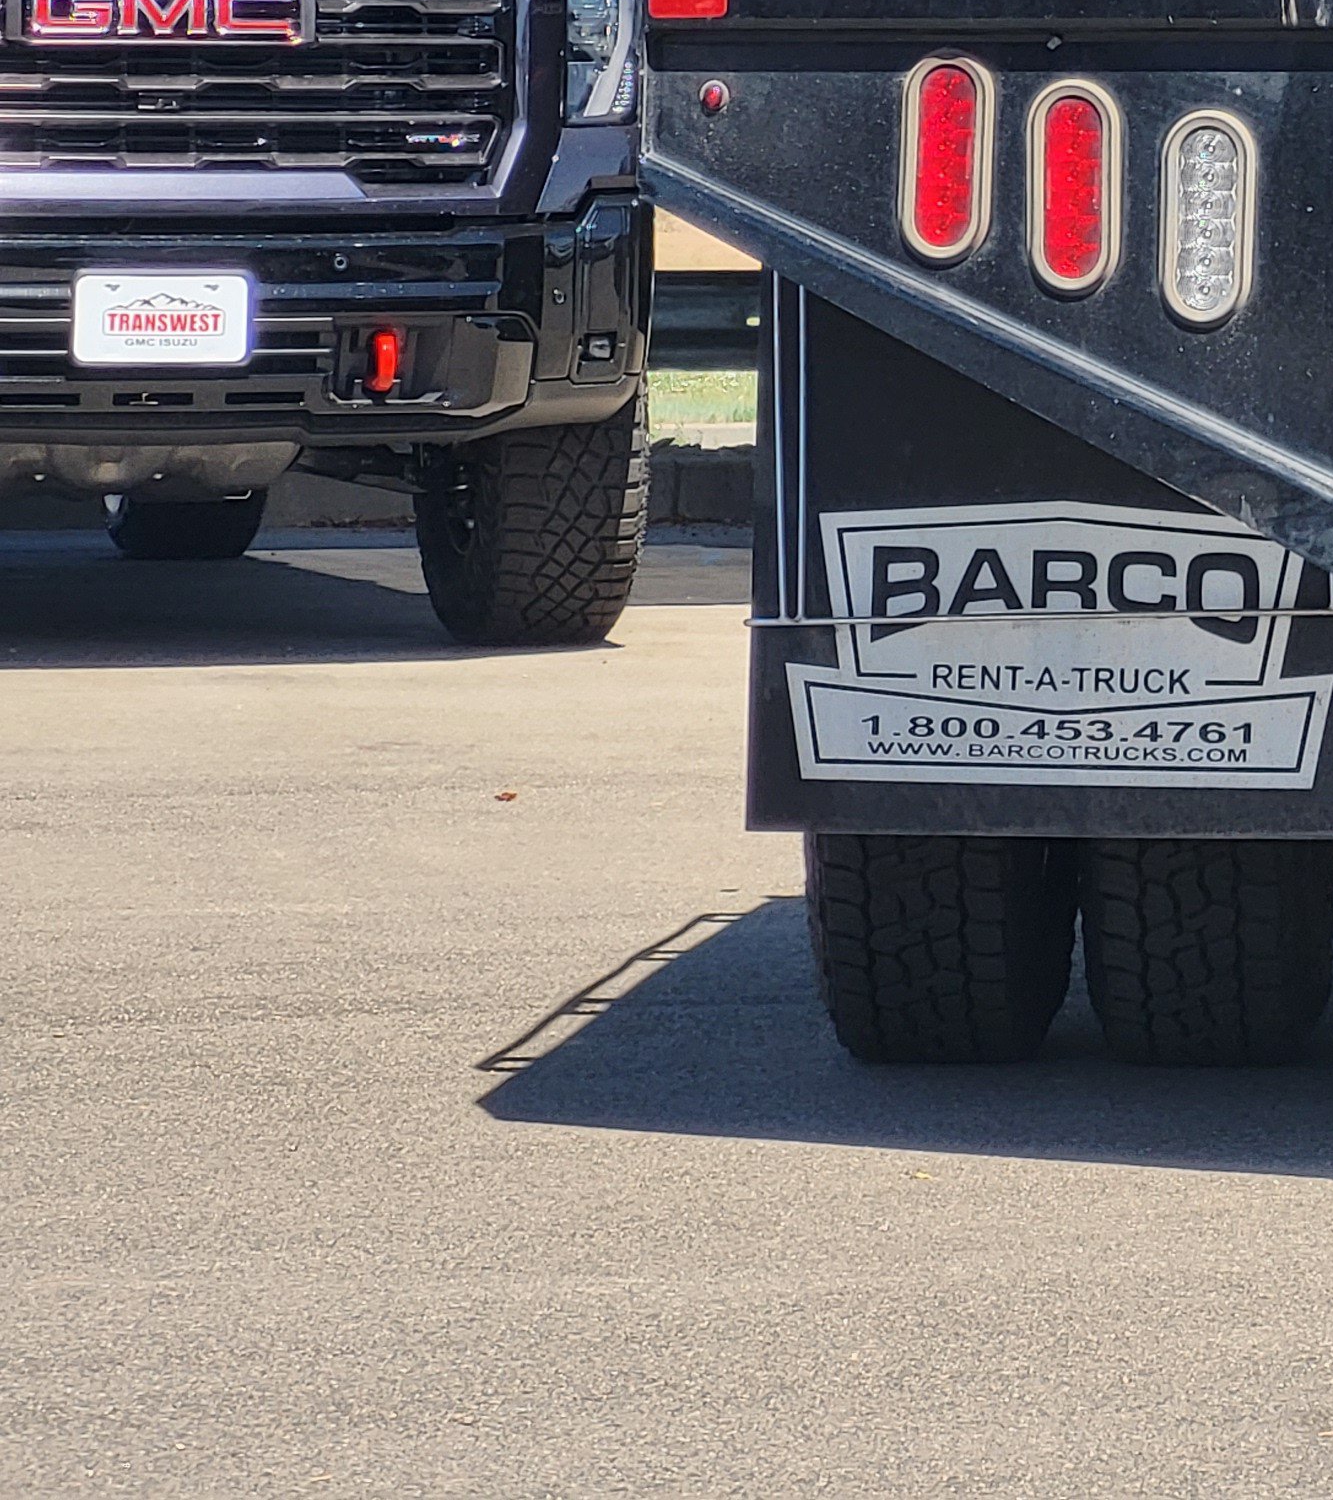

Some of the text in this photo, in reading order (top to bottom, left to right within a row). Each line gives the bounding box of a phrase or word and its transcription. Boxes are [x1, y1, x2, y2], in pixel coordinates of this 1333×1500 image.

[106, 312, 222, 332] TRANSWEST
[124, 338, 198, 347] GMC ISUZU
[869, 545, 1260, 645] BARCO
[931, 664, 1191, 695] RENT-A-TRUCK
[861, 715, 1254, 745] 1.800.453.4761
[867, 741, 1248, 763] WWW.BARCOTRUCKS.COM
